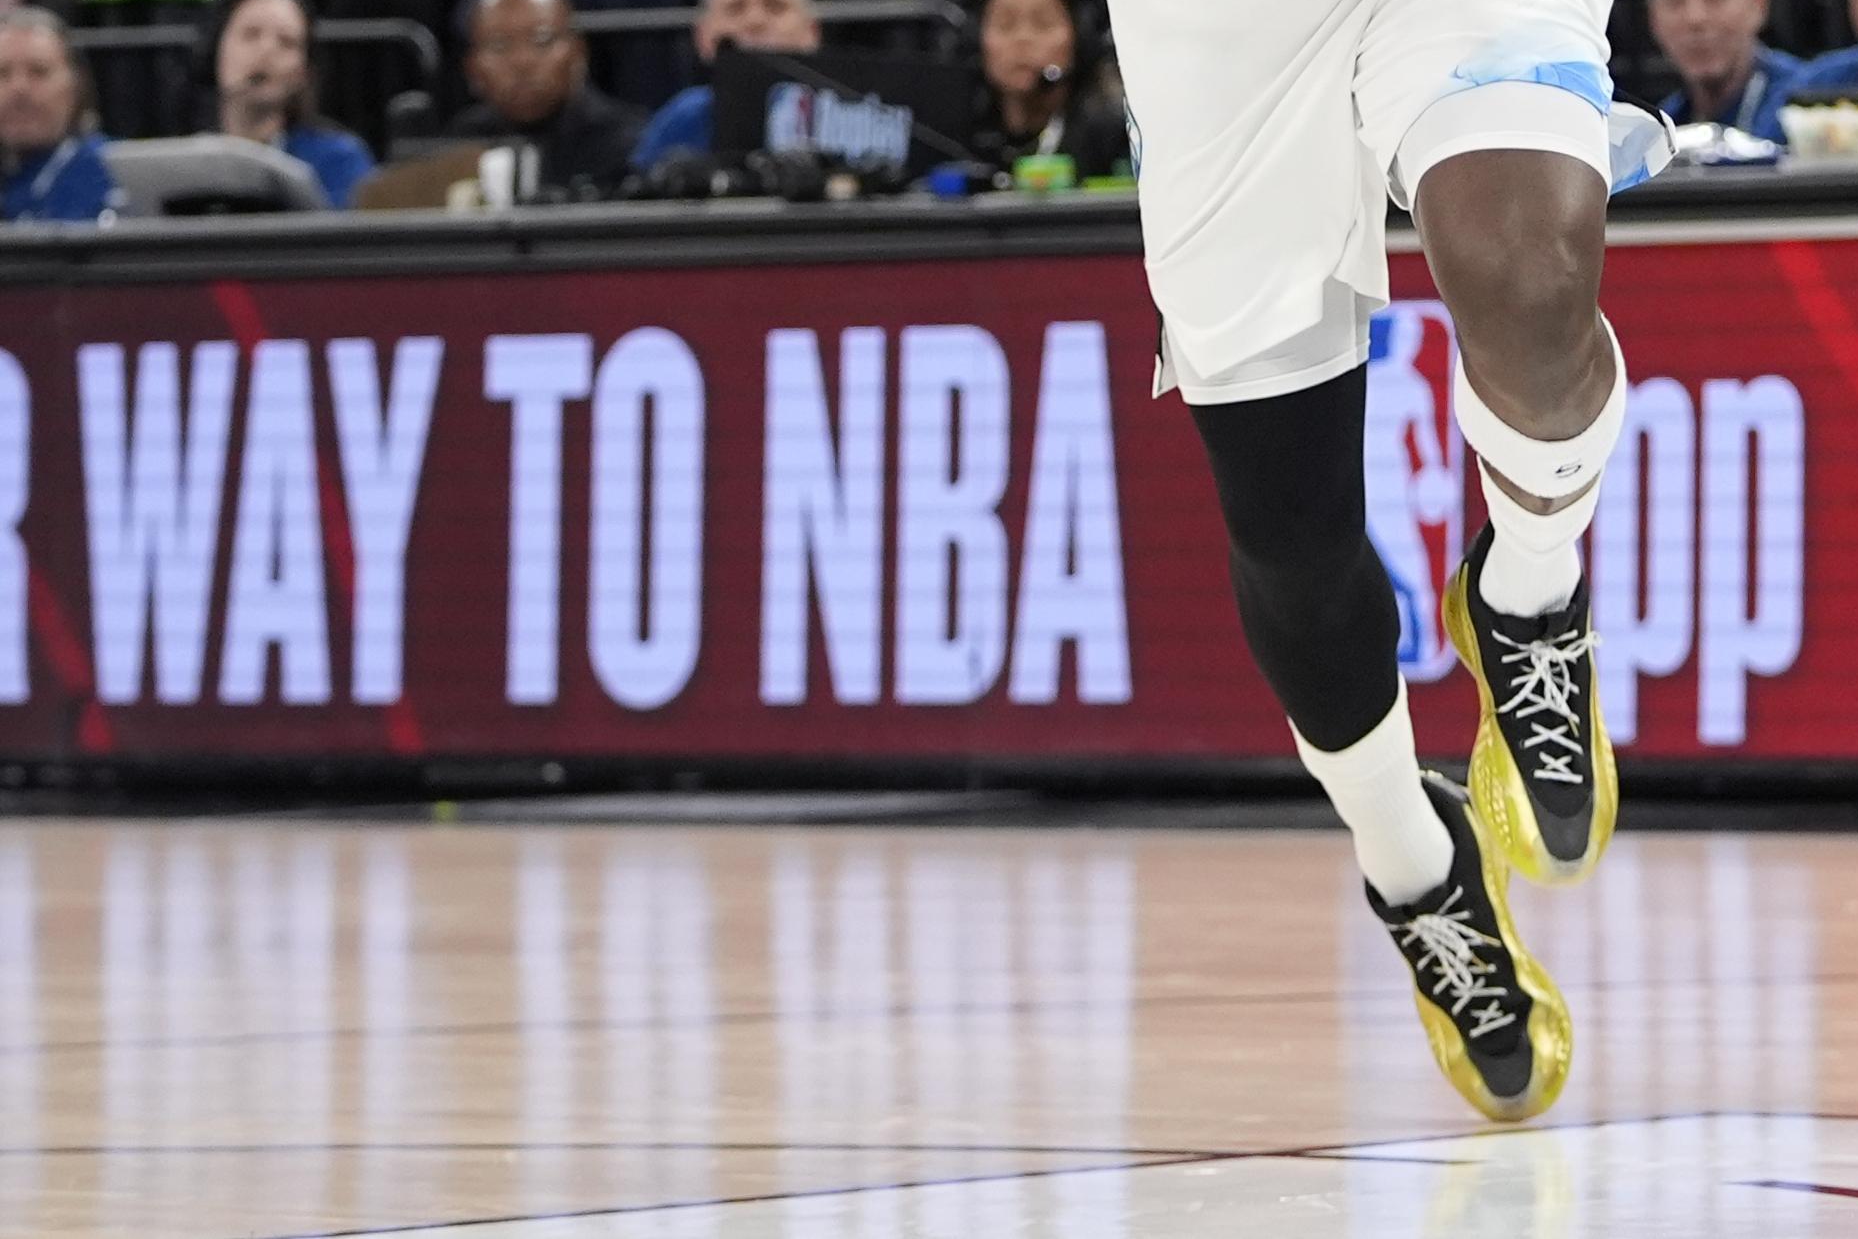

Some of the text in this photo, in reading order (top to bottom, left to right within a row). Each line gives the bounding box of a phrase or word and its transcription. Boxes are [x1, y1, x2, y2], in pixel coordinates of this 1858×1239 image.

[77, 335, 444, 705] WAY
[484, 326, 706, 709] TO
[760, 319, 1134, 705] NBA
[1590, 373, 1806, 747] pp
